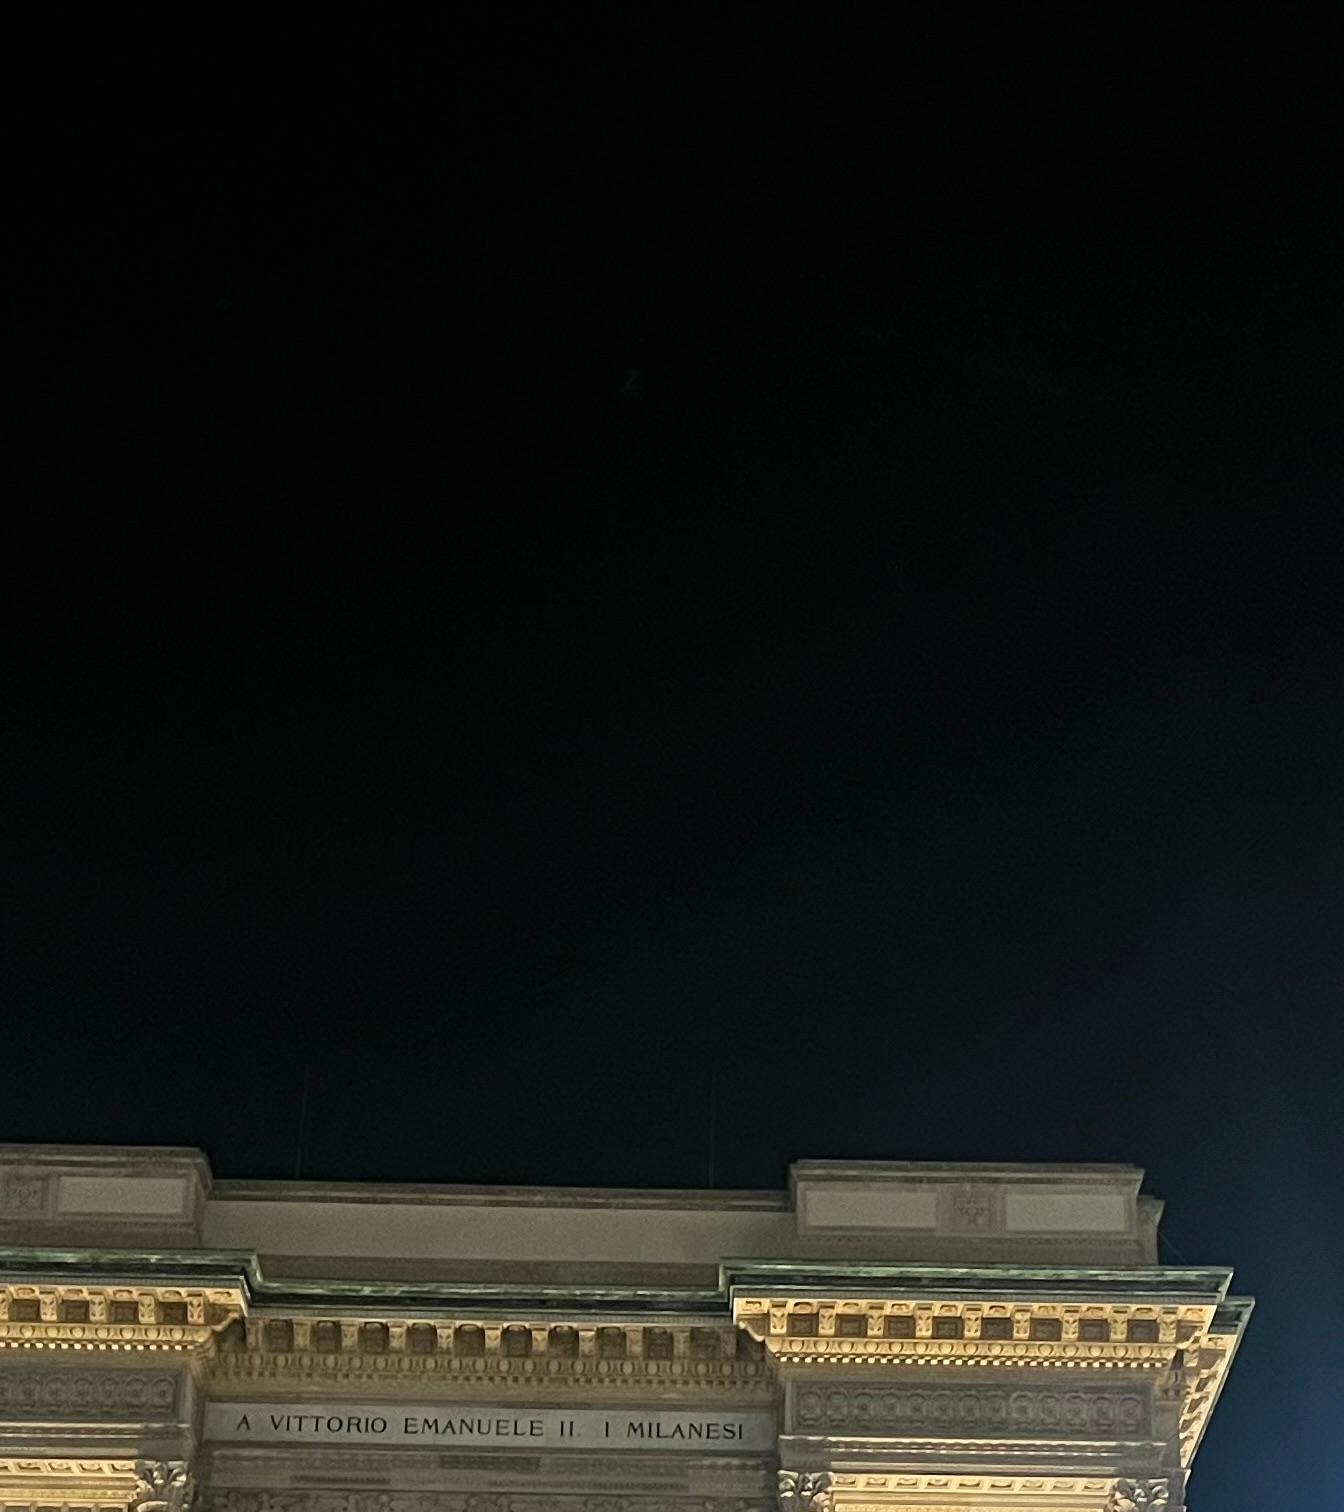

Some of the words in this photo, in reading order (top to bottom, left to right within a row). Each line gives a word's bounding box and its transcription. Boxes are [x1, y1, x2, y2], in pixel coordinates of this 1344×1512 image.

[236, 1415, 251, 1431] A
[270, 1415, 387, 1433] VITTORIO
[403, 1417, 544, 1437] EMANUELE
[626, 1421, 743, 1440] MILANESI
